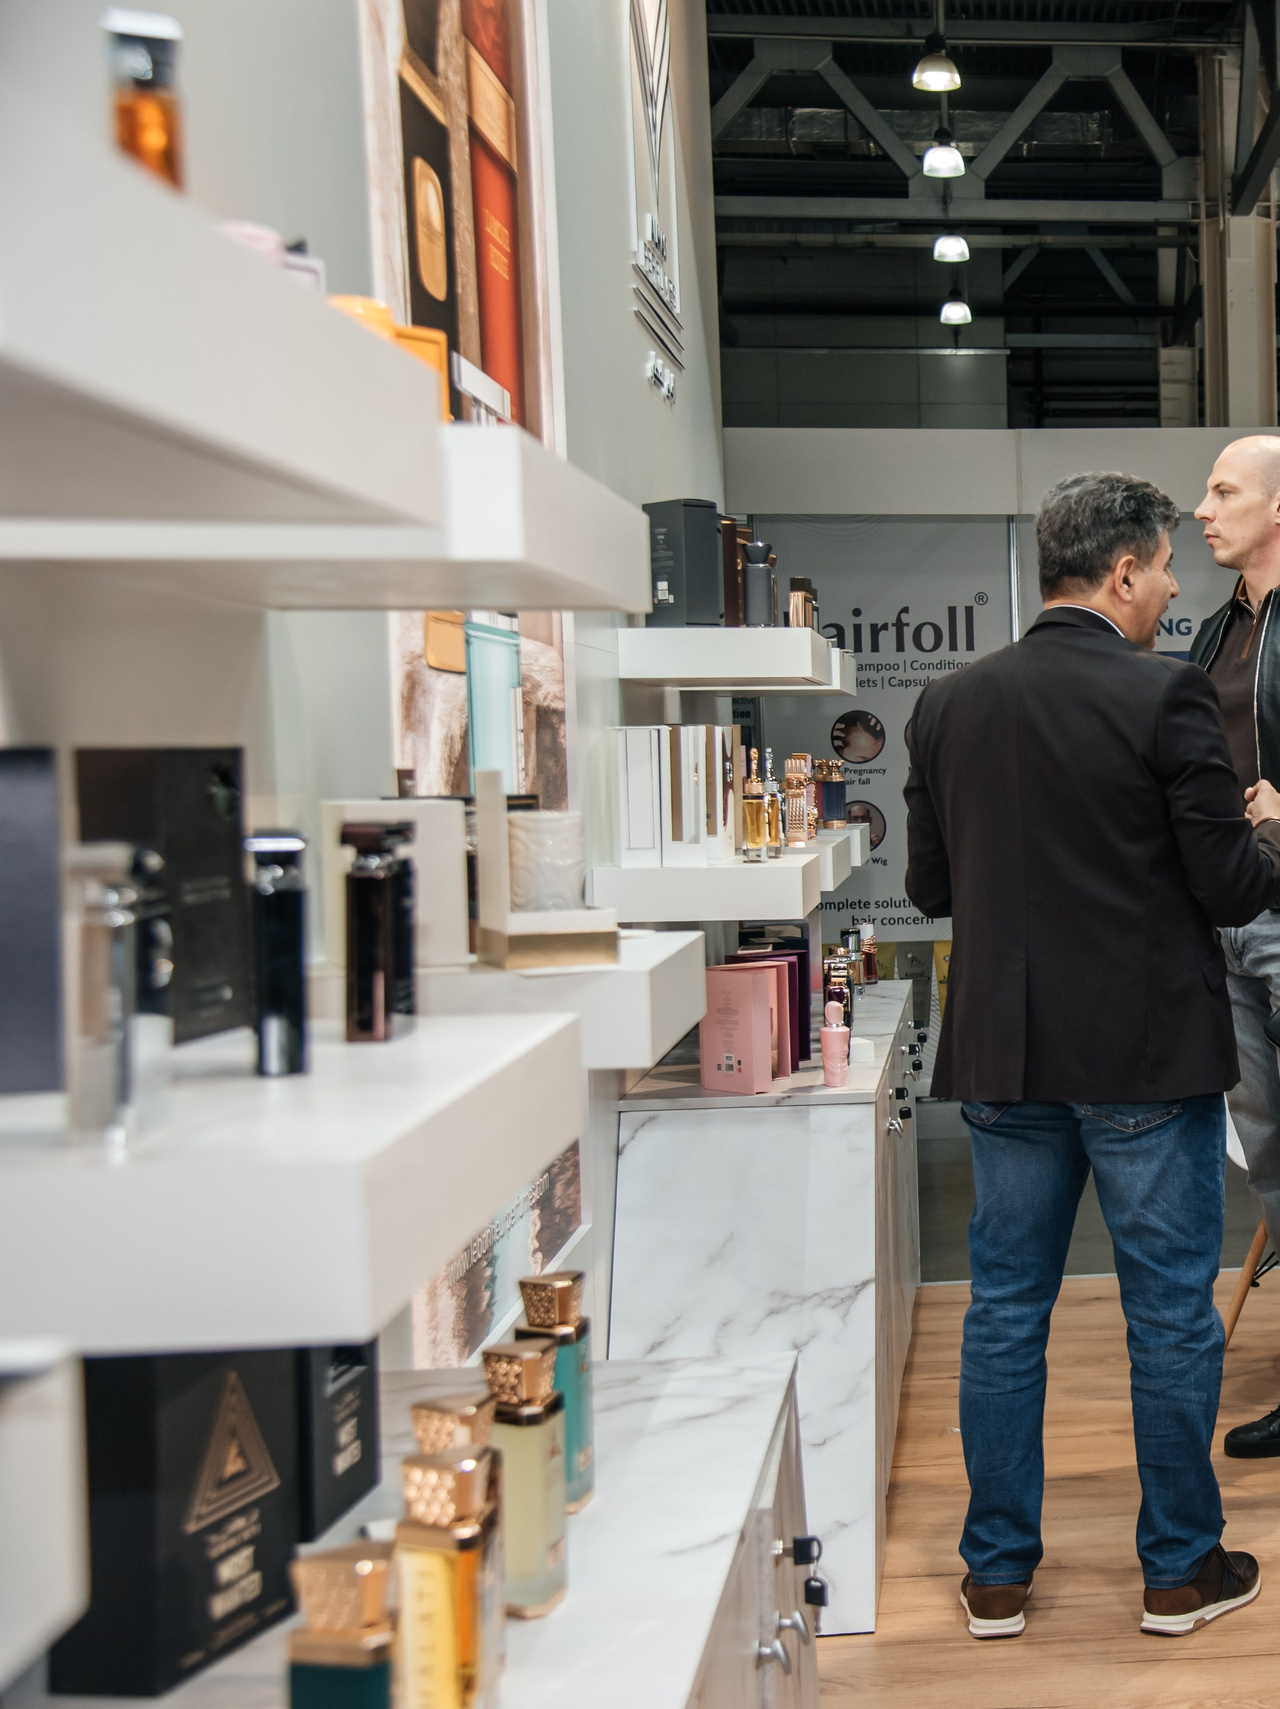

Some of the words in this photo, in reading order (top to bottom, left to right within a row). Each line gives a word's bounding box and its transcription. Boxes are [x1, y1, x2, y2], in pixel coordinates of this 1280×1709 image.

[857, 662, 900, 674] ampoo
[856, 676, 878, 688] lets
[845, 777, 857, 786] air
[858, 777, 871, 786] fall
[871, 857, 888, 867] Wig
[817, 897, 871, 913] omplete
